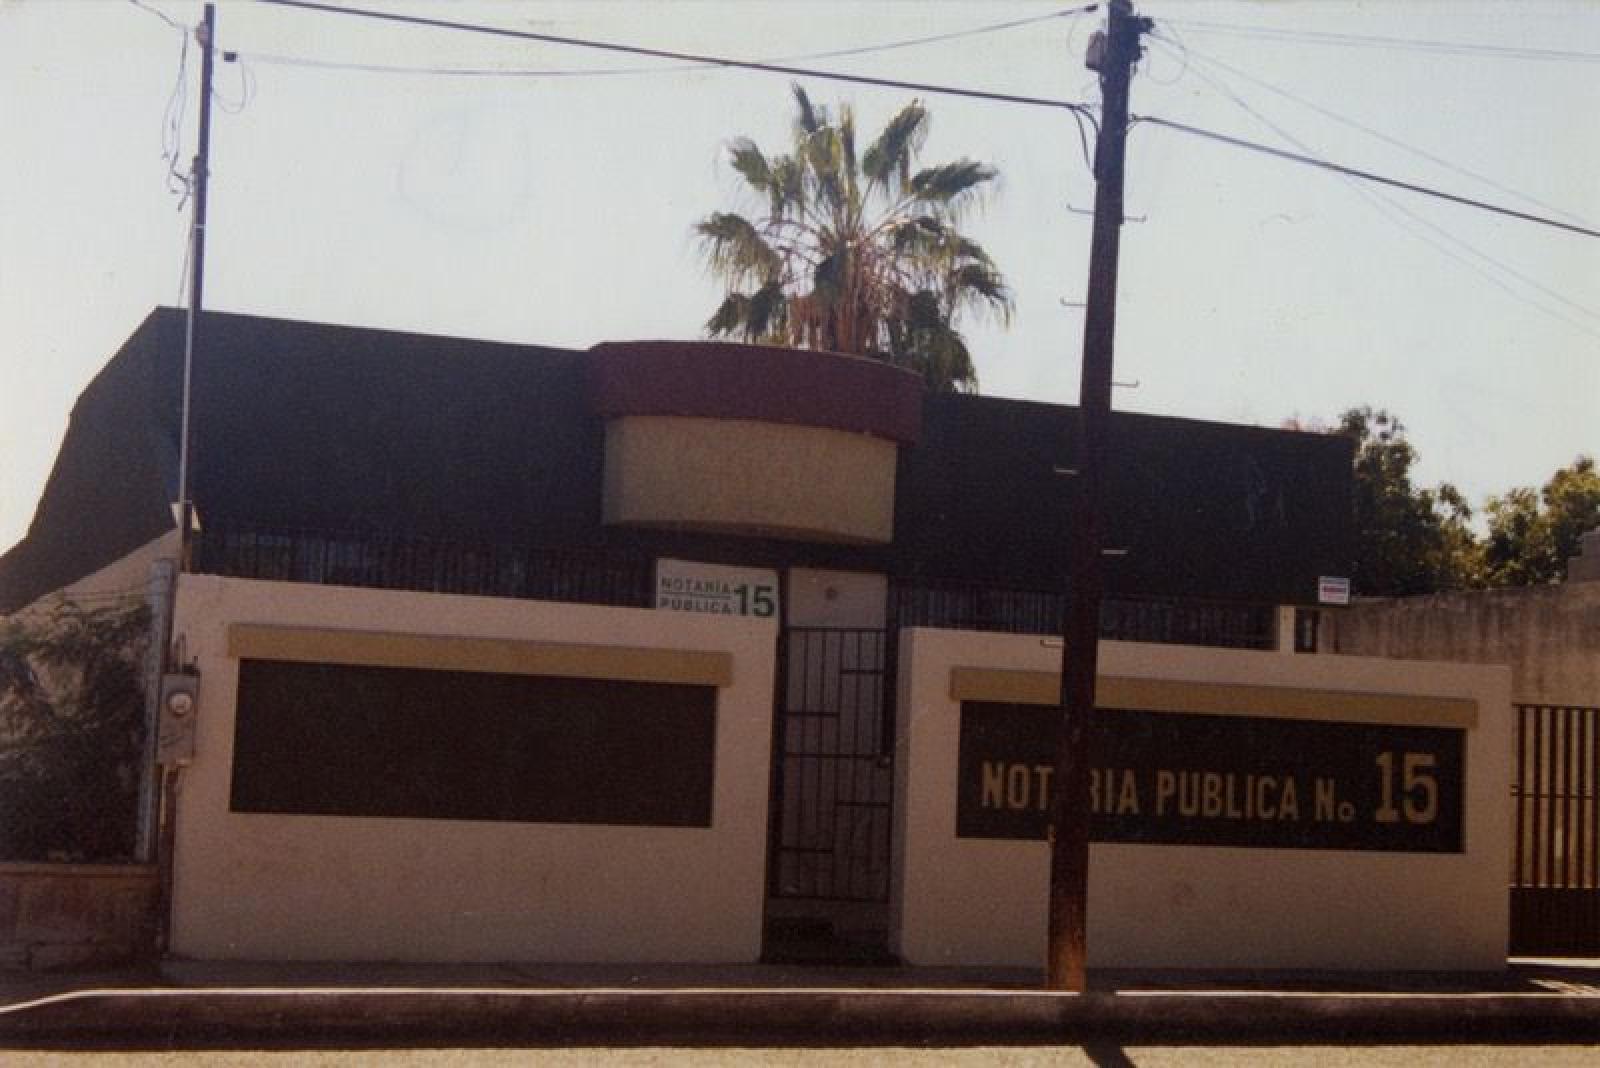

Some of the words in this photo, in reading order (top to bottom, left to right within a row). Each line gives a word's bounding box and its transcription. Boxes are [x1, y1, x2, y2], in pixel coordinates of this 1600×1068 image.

[735, 584, 775, 616] 15
[981, 760, 1140, 815] NOTRIA
[1156, 770, 1300, 821] PUBLICA
[1374, 751, 1439, 824] 15
